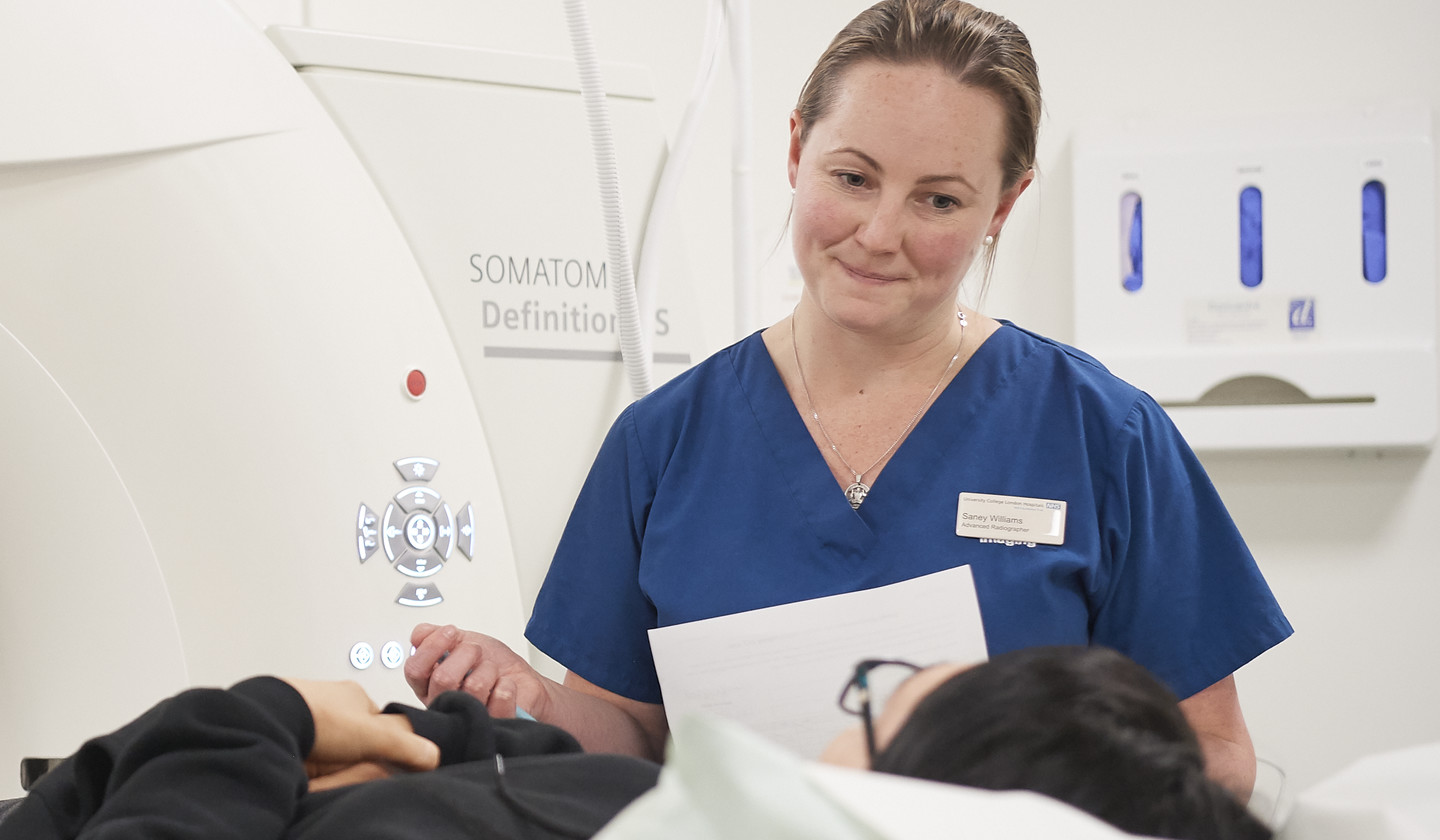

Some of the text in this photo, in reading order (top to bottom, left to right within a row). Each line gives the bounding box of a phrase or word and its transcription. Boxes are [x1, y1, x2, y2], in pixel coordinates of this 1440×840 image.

[469, 253, 607, 289] SOMATOM
[1046, 502, 1061, 510] NHS
[989, 514, 1023, 525] Williams
[961, 522, 1030, 533] Advanced Radiographer
